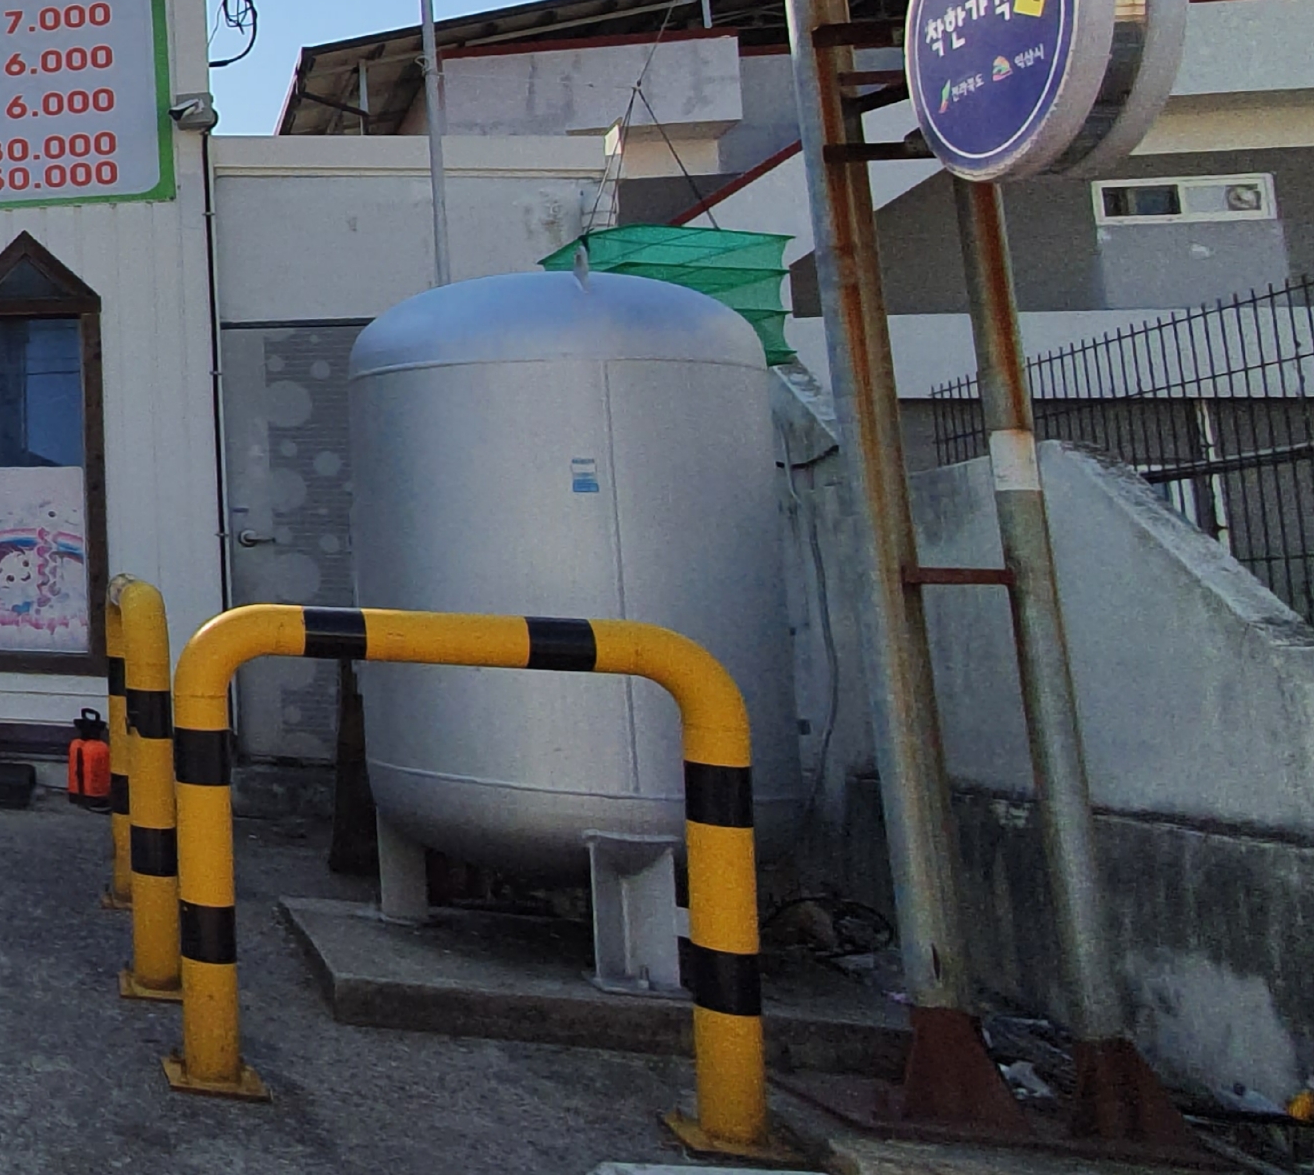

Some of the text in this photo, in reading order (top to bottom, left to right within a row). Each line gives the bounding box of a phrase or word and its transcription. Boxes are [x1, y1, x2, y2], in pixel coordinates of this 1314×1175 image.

[4, 2, 112, 35] 7.000
[4, 45, 114, 77] 6.000
[5, 87, 115, 120] 6.000
